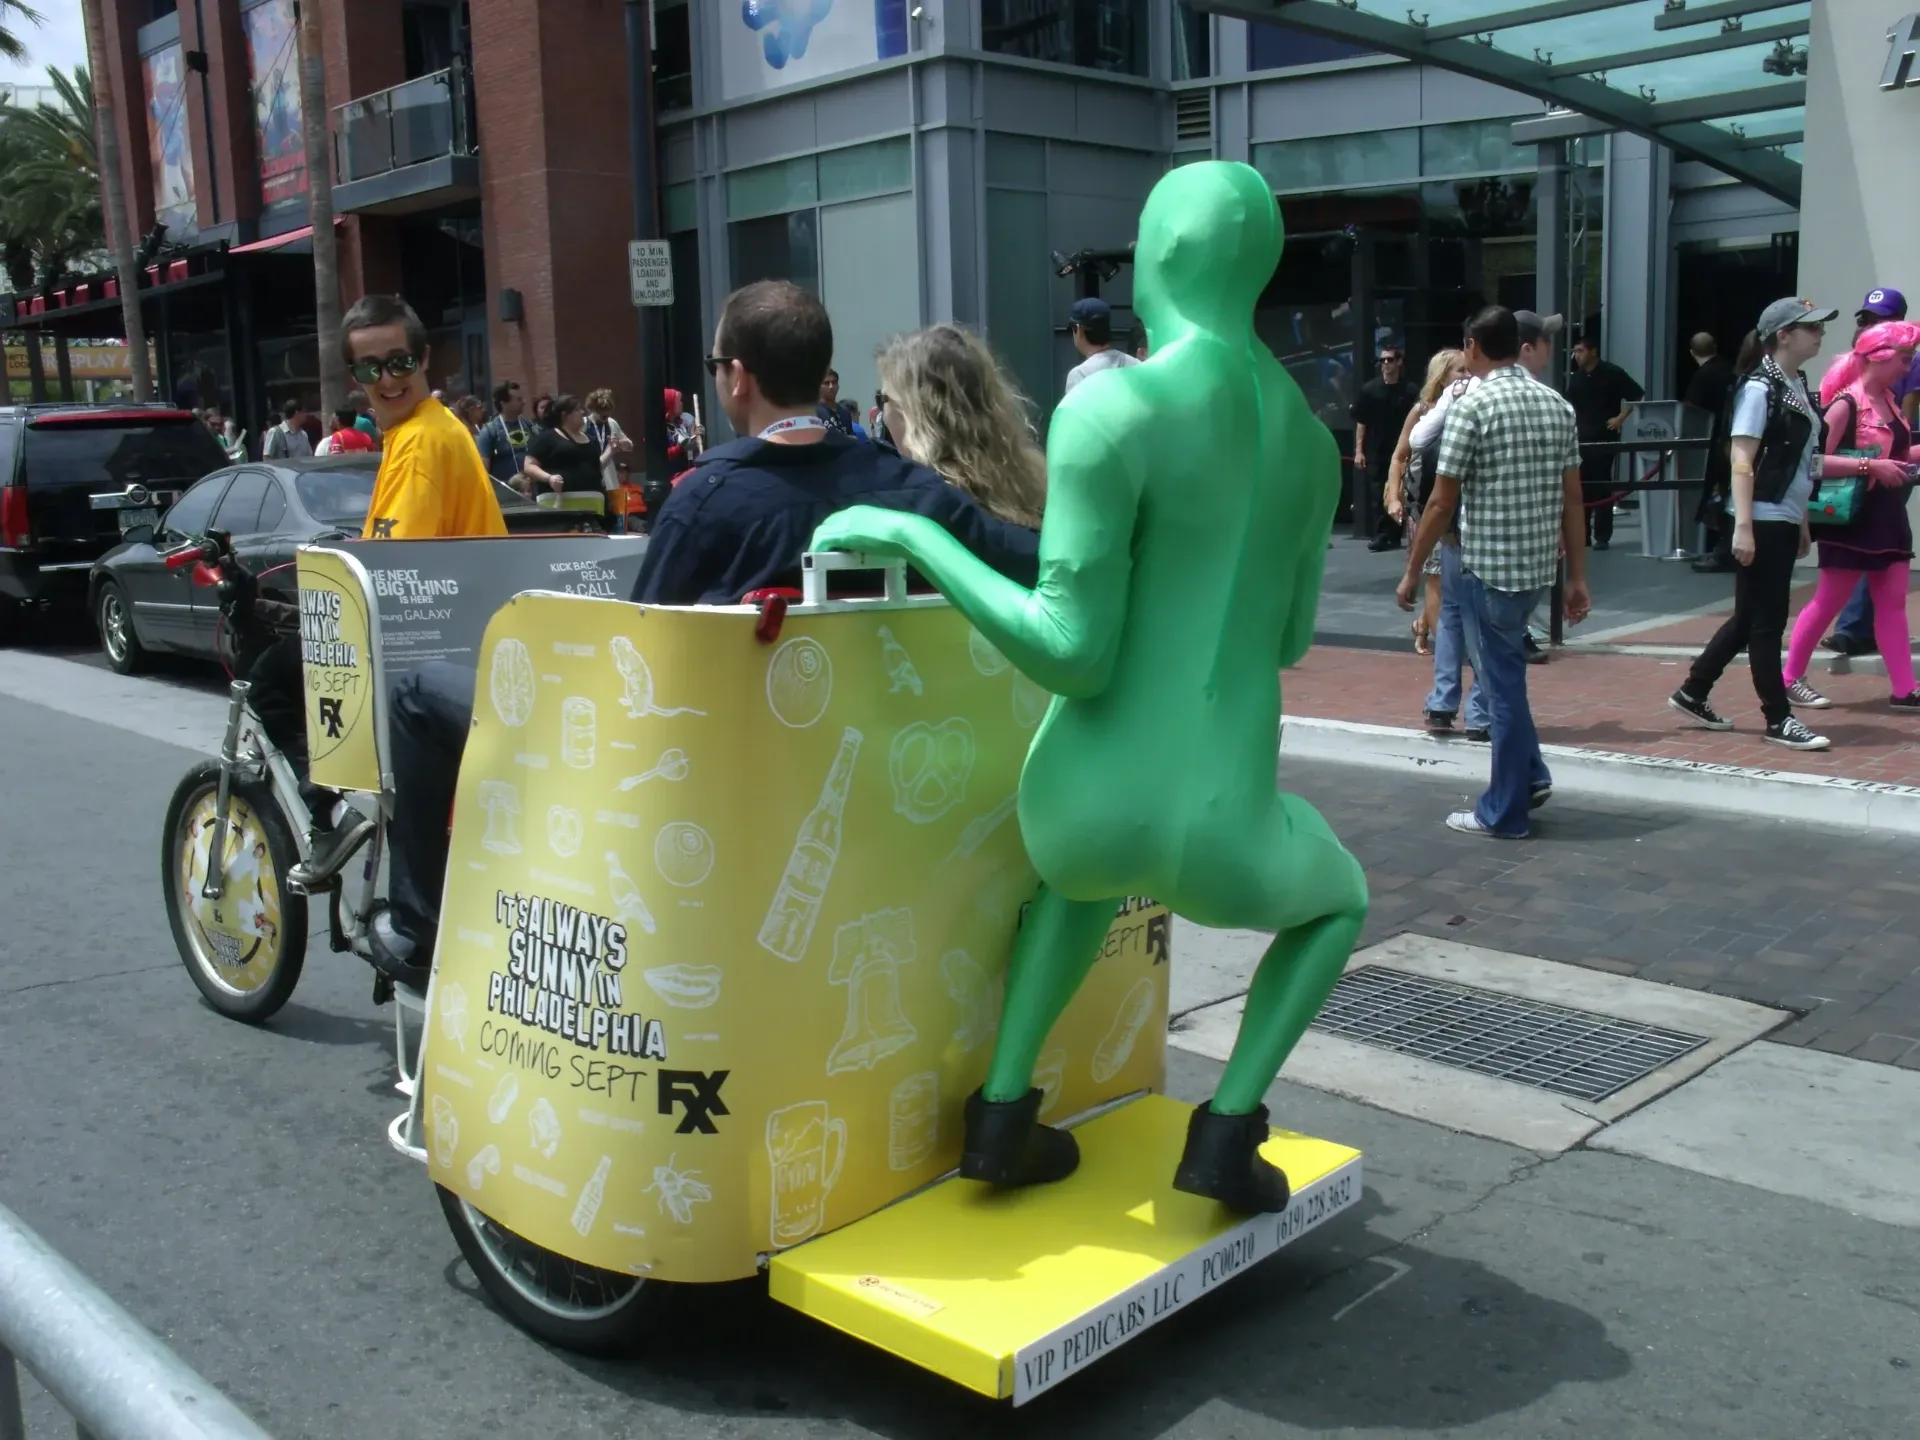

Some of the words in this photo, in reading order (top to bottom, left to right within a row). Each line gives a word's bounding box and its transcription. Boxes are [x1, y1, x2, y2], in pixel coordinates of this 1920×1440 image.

[637, 247, 646, 256] 10
[649, 247, 664, 256] MIN
[632, 257, 669, 267] PASSENGER
[637, 268, 666, 278] LOADING
[645, 279, 659, 288] AND
[634, 288, 671, 299] UNLOADING
[549, 563, 573, 572] KICK
[386, 569, 419, 581] NEXT
[581, 569, 617, 581] RELAX
[376, 580, 405, 596] BIG
[405, 579, 459, 596] THING
[576, 581, 616, 596] CALL
[399, 596, 409, 604] IS
[410, 595, 434, 604] HERE
[404, 608, 452, 621] GALAXY
[323, 670, 360, 696] SEPT
[496, 889, 528, 930] IT'S
[527, 895, 627, 971] ALWAYS
[508, 928, 600, 1008] SUNNY
[594, 970, 622, 1008] IN
[488, 971, 667, 1061] PHILADELPHIA
[480, 1020, 561, 1079] COMING
[570, 1054, 647, 1102] SEPT
[1024, 1348, 1055, 1391] VIP
[1062, 1295, 1145, 1371] PEDICABS
[1152, 1273, 1185, 1317] LLC
[1202, 1232, 1256, 1288] PC00210
[1276, 1204, 1304, 1249] (619)
